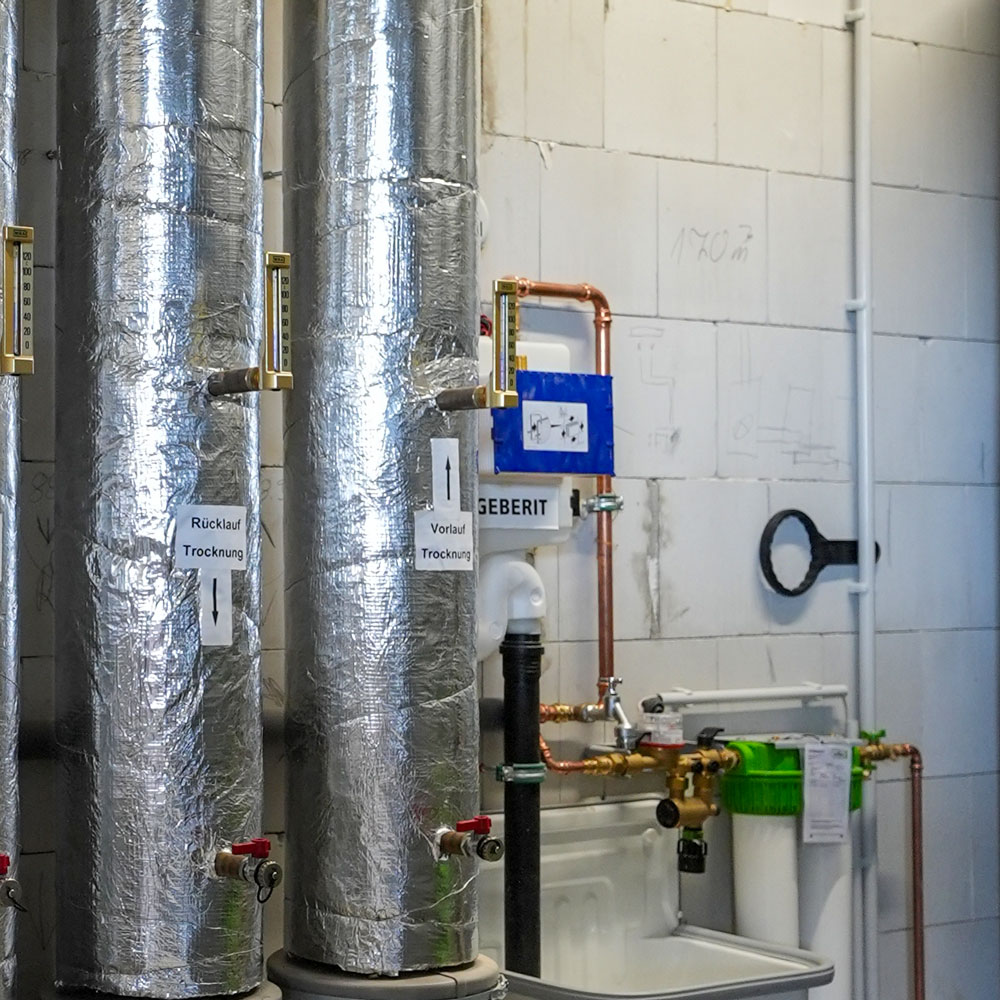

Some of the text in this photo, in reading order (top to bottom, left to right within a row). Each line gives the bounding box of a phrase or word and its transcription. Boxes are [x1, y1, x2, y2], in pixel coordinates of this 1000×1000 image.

[22, 252, 32, 261] 120
[22, 267, 32, 276] 100
[23, 282, 31, 291] 80
[23, 297, 31, 306] 60
[23, 312, 31, 321] 40
[23, 327, 31, 336] 20
[25, 341, 30, 349] 0
[478, 498, 547, 515] GEBERIT
[191, 516, 241, 531] Rücklauf
[430, 523, 466, 535] Vorlauf
[183, 544, 244, 562] Trocknung
[421, 548, 471, 562] Trocknung
